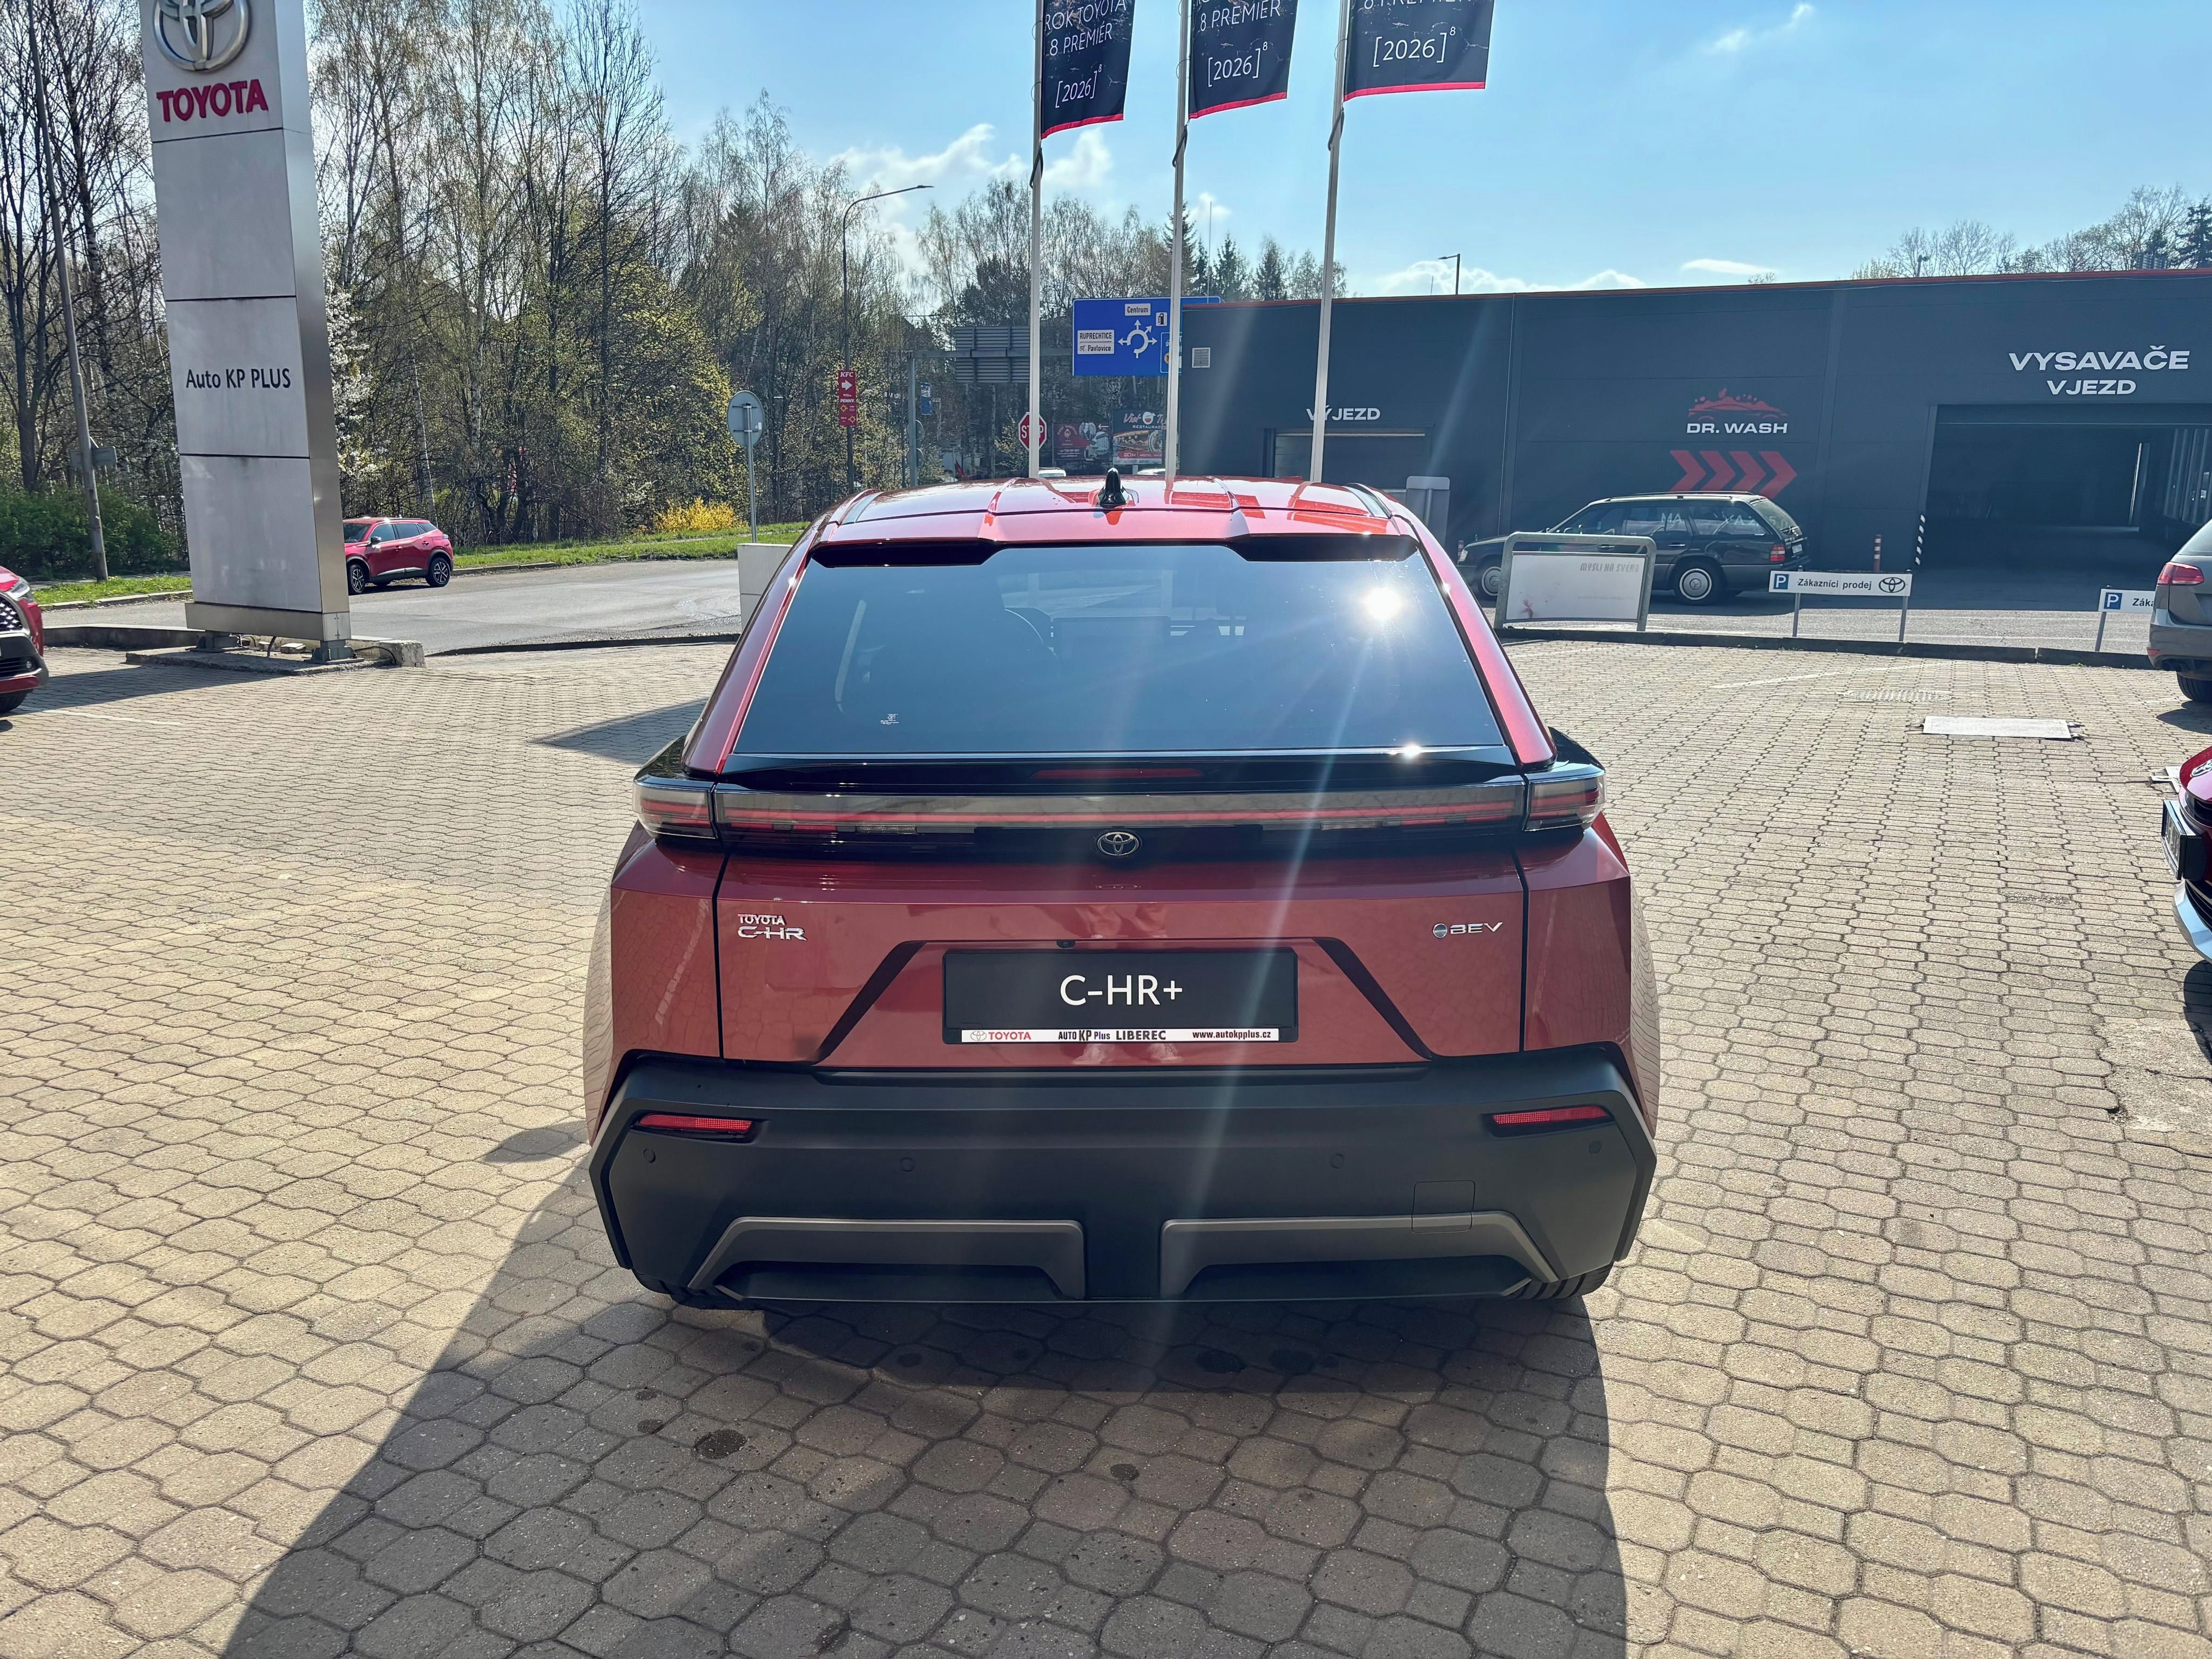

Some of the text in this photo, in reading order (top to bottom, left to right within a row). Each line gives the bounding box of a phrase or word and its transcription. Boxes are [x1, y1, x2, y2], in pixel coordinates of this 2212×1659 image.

[1044, 0, 1127, 31] ROK TOYOTA
[1201, 13, 1206, 31] 8
[1050, 21, 1112, 56] 8 PREMIÉR
[156, 79, 269, 122] TOYOTA
[2008, 345, 2190, 370] VYSAVAČE
[186, 368, 291, 389] Auto KP PLUS
[2047, 380, 2137, 395] VJEZD
[1021, 425, 1044, 438] SP
[1687, 423, 1788, 434] DR. WASH
[1604, 563, 1614, 572] NA
[1798, 578, 1839, 588] Zákazníci
[1843, 581, 1872, 590] prodej
[2132, 598, 2155, 607] Záka
[738, 914, 785, 925] TOYOTA
[738, 926, 807, 941] C-HR
[1450, 922, 1503, 934] BEV
[1060, 975, 1183, 1006] C-HR+
[988, 1029, 1271, 1041] TOYOTA AUTO KP Plus LIBEREC www.autokpplus.cz
